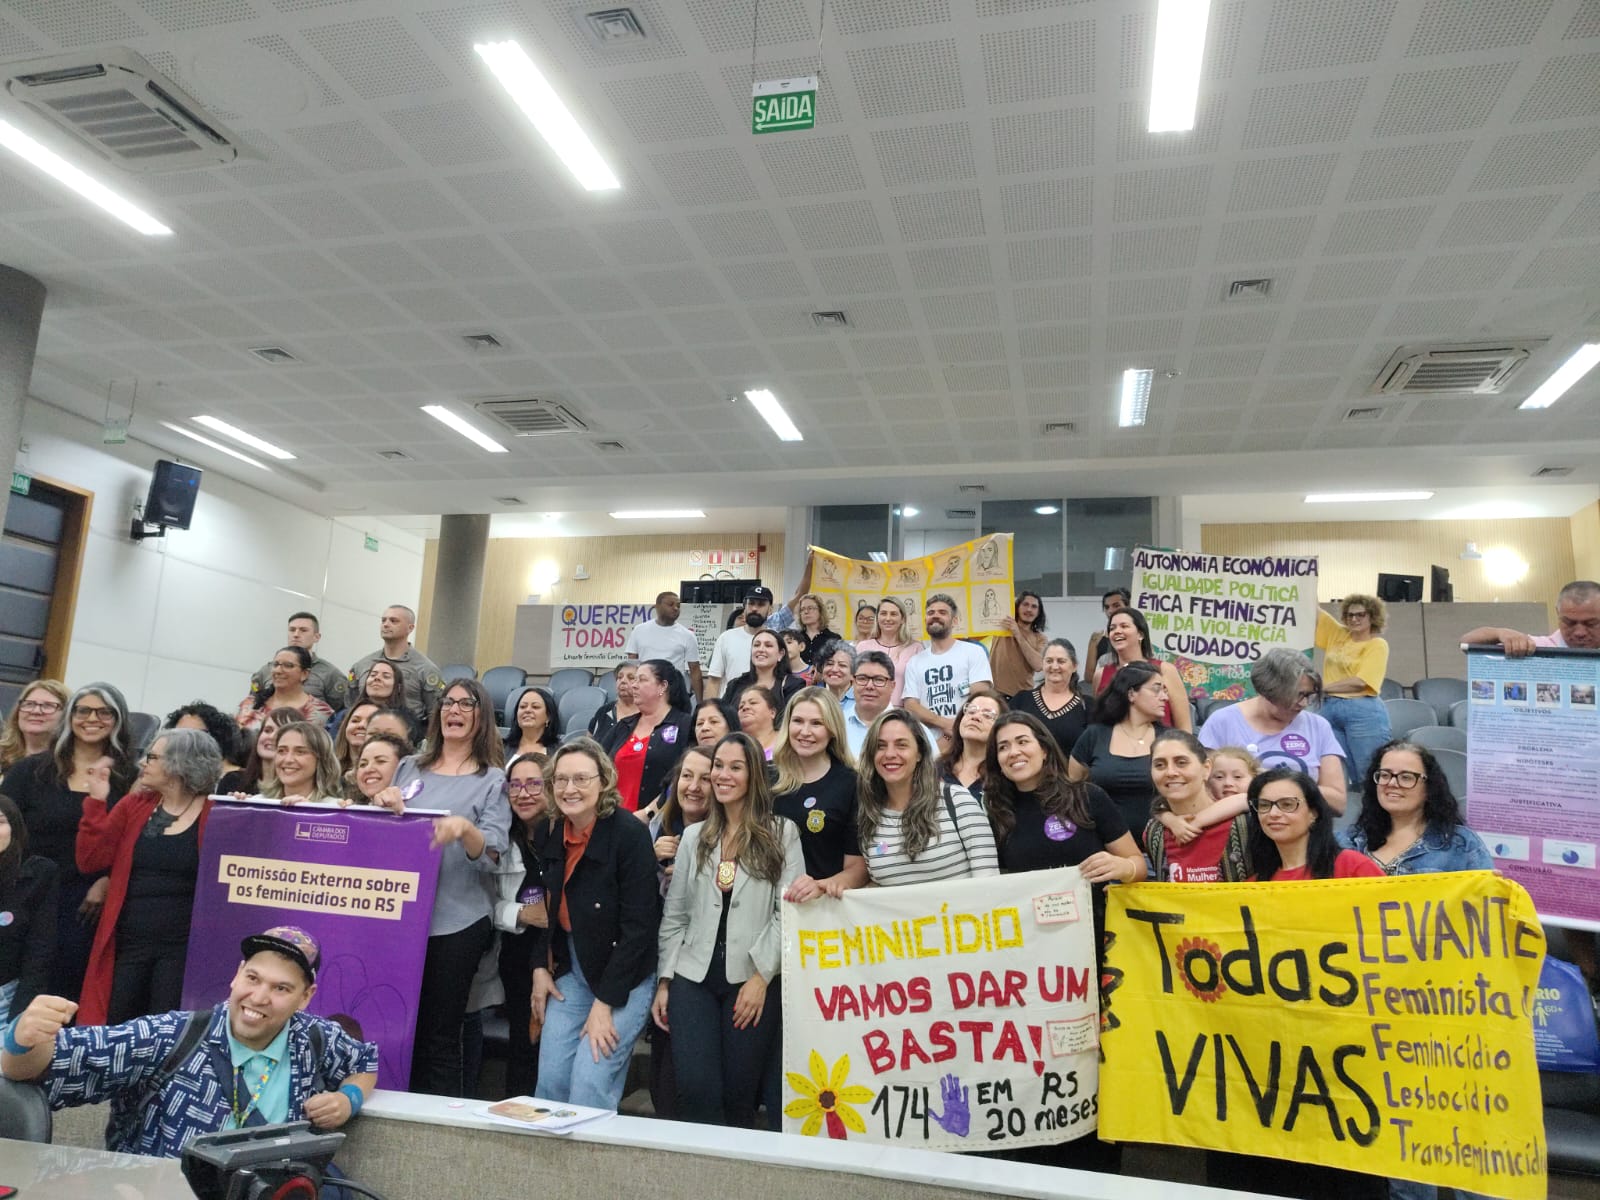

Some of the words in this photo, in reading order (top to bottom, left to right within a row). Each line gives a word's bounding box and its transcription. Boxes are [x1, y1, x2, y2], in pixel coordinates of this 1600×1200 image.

[755, 94, 812, 123] SAÍDA
[561, 627, 626, 649] TODAS
[1173, 616, 1195, 632] DA
[924, 664, 953, 685] GO
[933, 684, 945, 693] TO
[933, 697, 947, 705] THE
[1510, 798, 1562, 808] JUSTIFICATIVA
[226, 863, 297, 884] Comissão
[300, 870, 362, 890] Externa
[365, 877, 411, 894] sobre
[236, 885, 252, 897] os
[350, 896, 371, 910] no
[374, 898, 396, 913] RS
[797, 901, 1025, 970] FEMINICÍDIO
[1353, 895, 1542, 964] LEVANTE
[1125, 905, 1360, 1008] Todas
[813, 976, 933, 1022] VAMOS
[947, 969, 1028, 1011] DAR
[1037, 964, 1090, 1004] UM
[1361, 971, 1518, 1020] Feminista
[862, 1020, 1046, 1078] BASTA!
[1371, 1023, 1511, 1071] Feminicídio
[871, 1085, 930, 1140] 174
[976, 1078, 1014, 1106] EM
[1041, 1070, 1078, 1106] RS
[1155, 1029, 1381, 1148] VIVAS
[1383, 1071, 1510, 1115] Lesbocídio
[986, 1107, 1026, 1141] 20
[1034, 1093, 1099, 1131] meses
